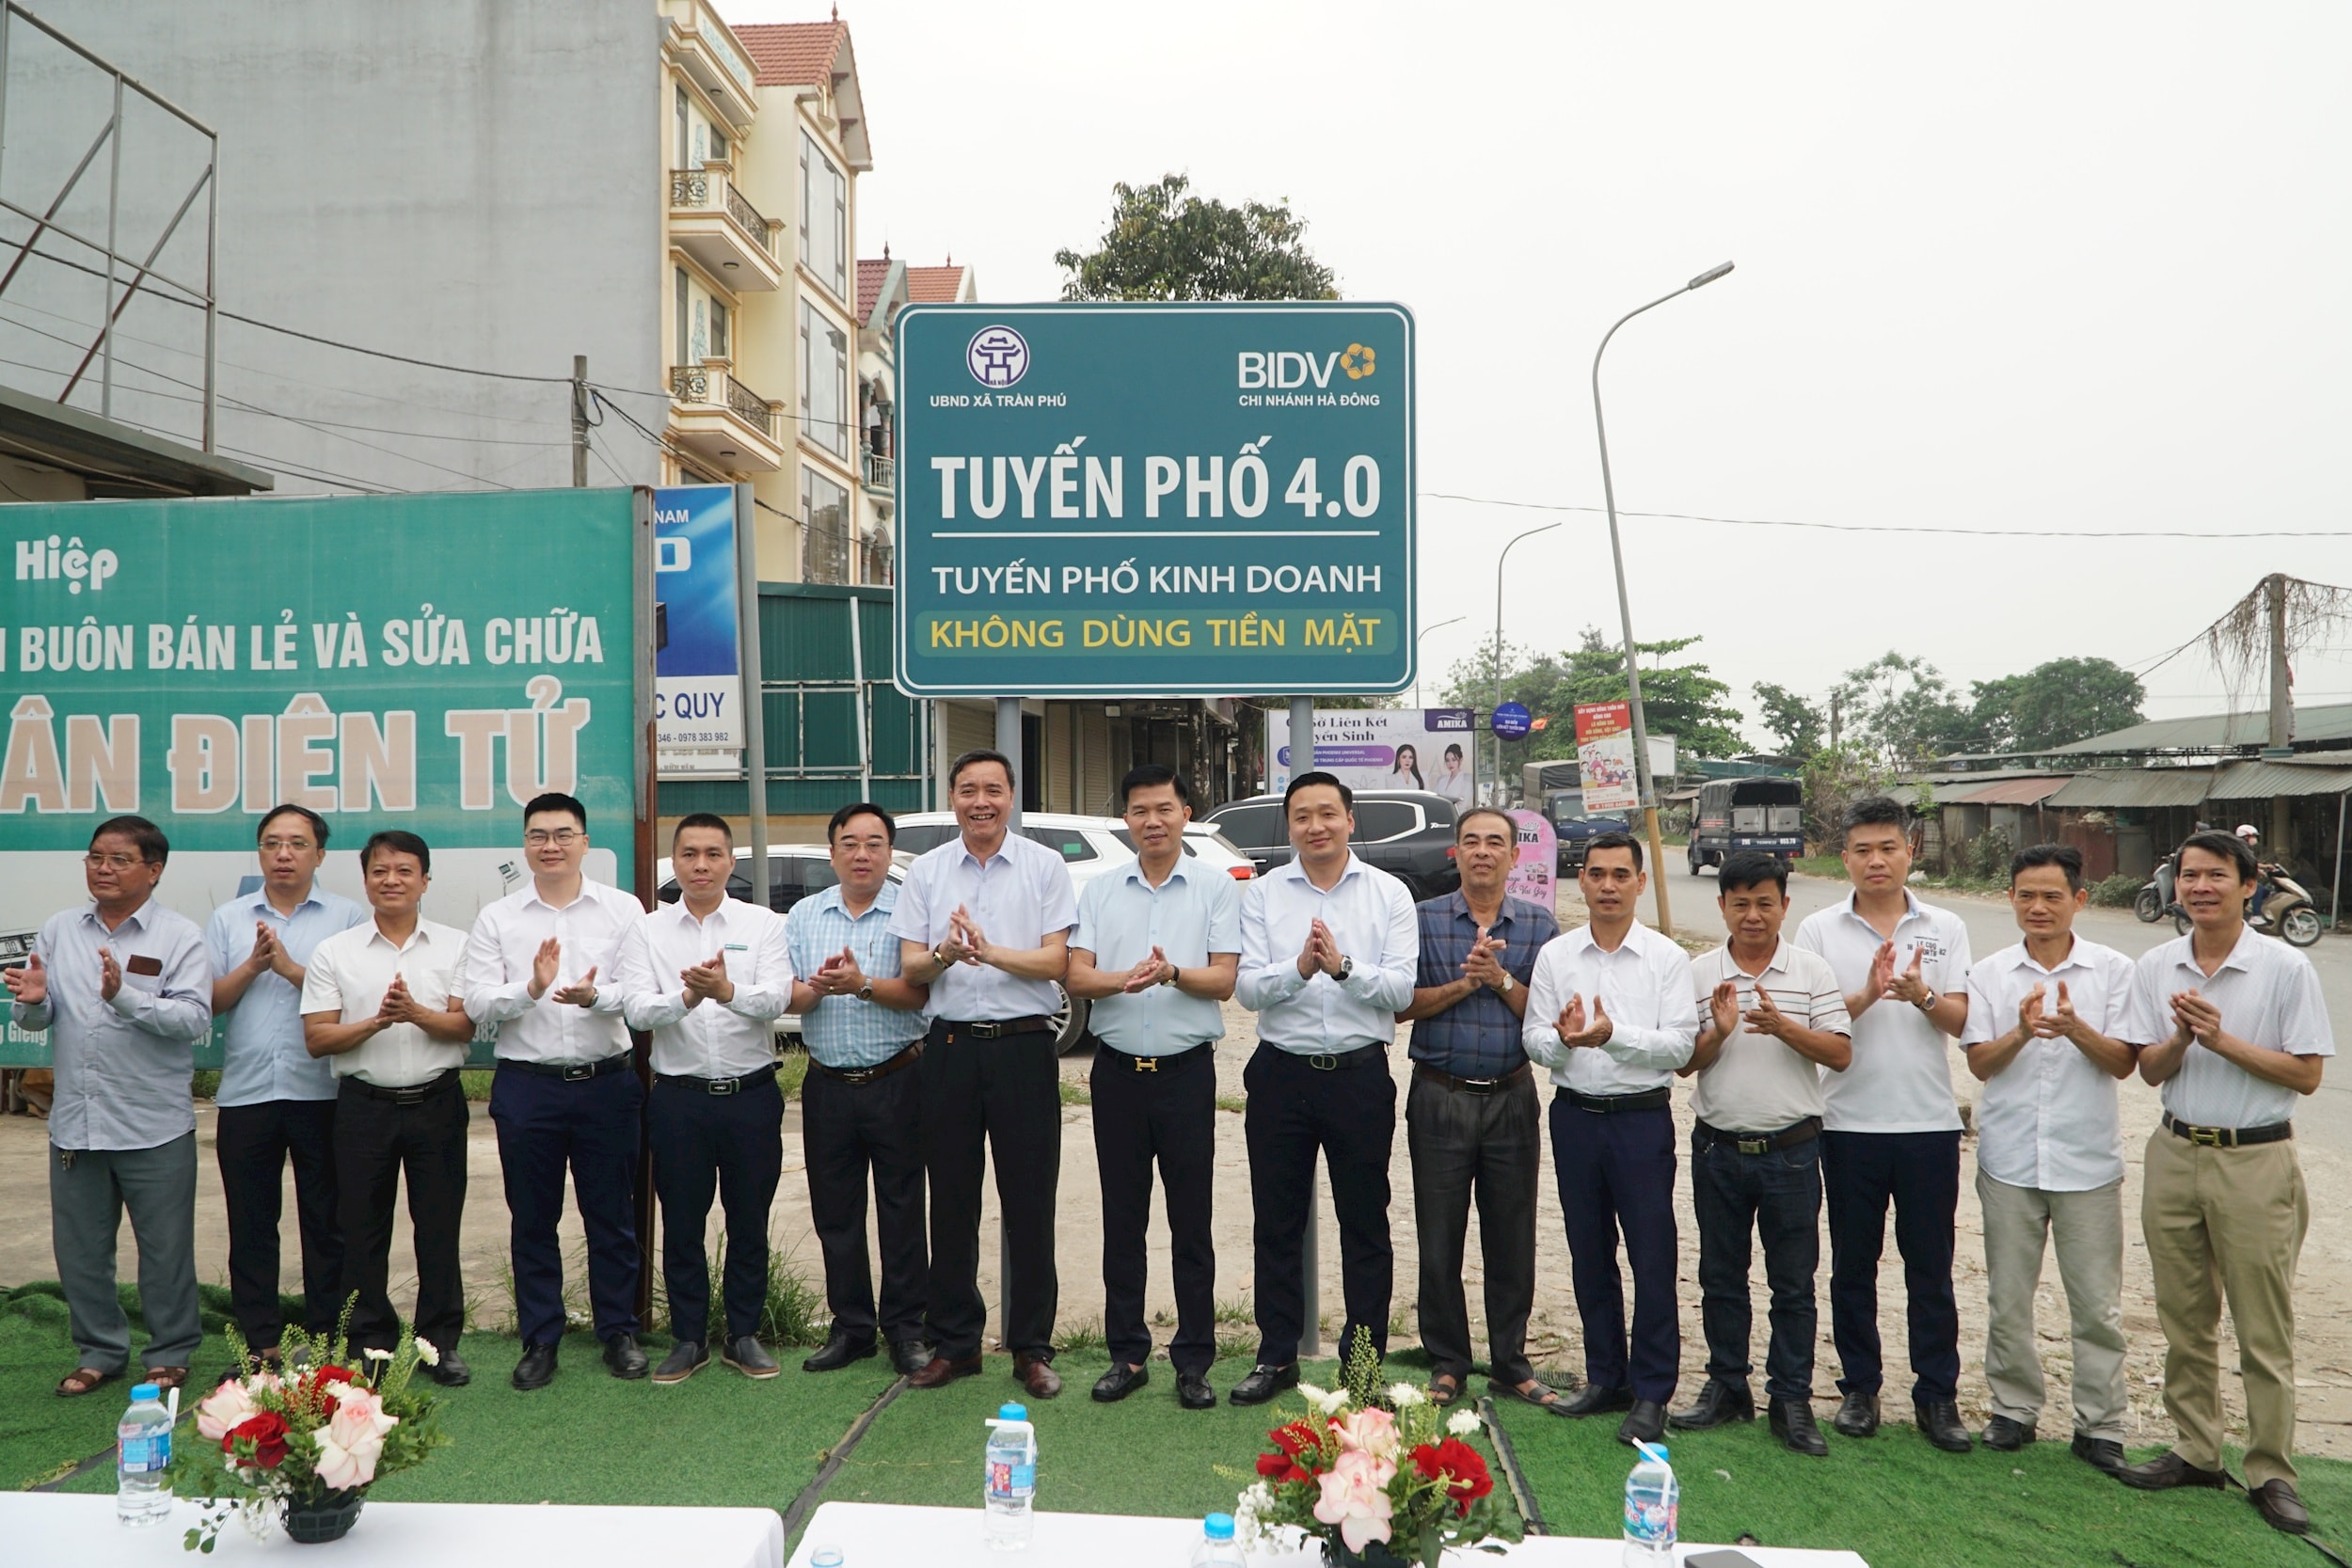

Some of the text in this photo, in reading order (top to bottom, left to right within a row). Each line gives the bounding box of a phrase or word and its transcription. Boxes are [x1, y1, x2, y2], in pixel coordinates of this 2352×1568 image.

[1239, 352, 1341, 388] BIDV
[930, 395, 969, 406] UBND
[973, 393, 993, 406] XÃ
[1038, 392, 1067, 406] PHÚ
[1239, 392, 1380, 406] CHI NHÁNH HÀ ĐÔNG
[931, 436, 1380, 518] TUYẾN PHỐ 4.0
[15, 534, 119, 594] Hiệp
[931, 557, 1381, 594] TUYẾN PHỐ KINH DOANH
[20, 615, 134, 672] BUÔN
[148, 614, 235, 670] BÁN
[250, 609, 297, 670] LẺ
[312, 611, 369, 669] VÀ
[382, 603, 470, 666] SỬA
[485, 607, 604, 664] CHỮA
[931, 610, 1381, 653] KHÔNG DÙNG TIỀN MẶT
[675, 692, 724, 720] QUY
[1438, 720, 1467, 728] AMIKA
[444, 674, 591, 810] TỬ
[699, 733, 712, 741] 383
[1343, 731, 1374, 741] Sinh
